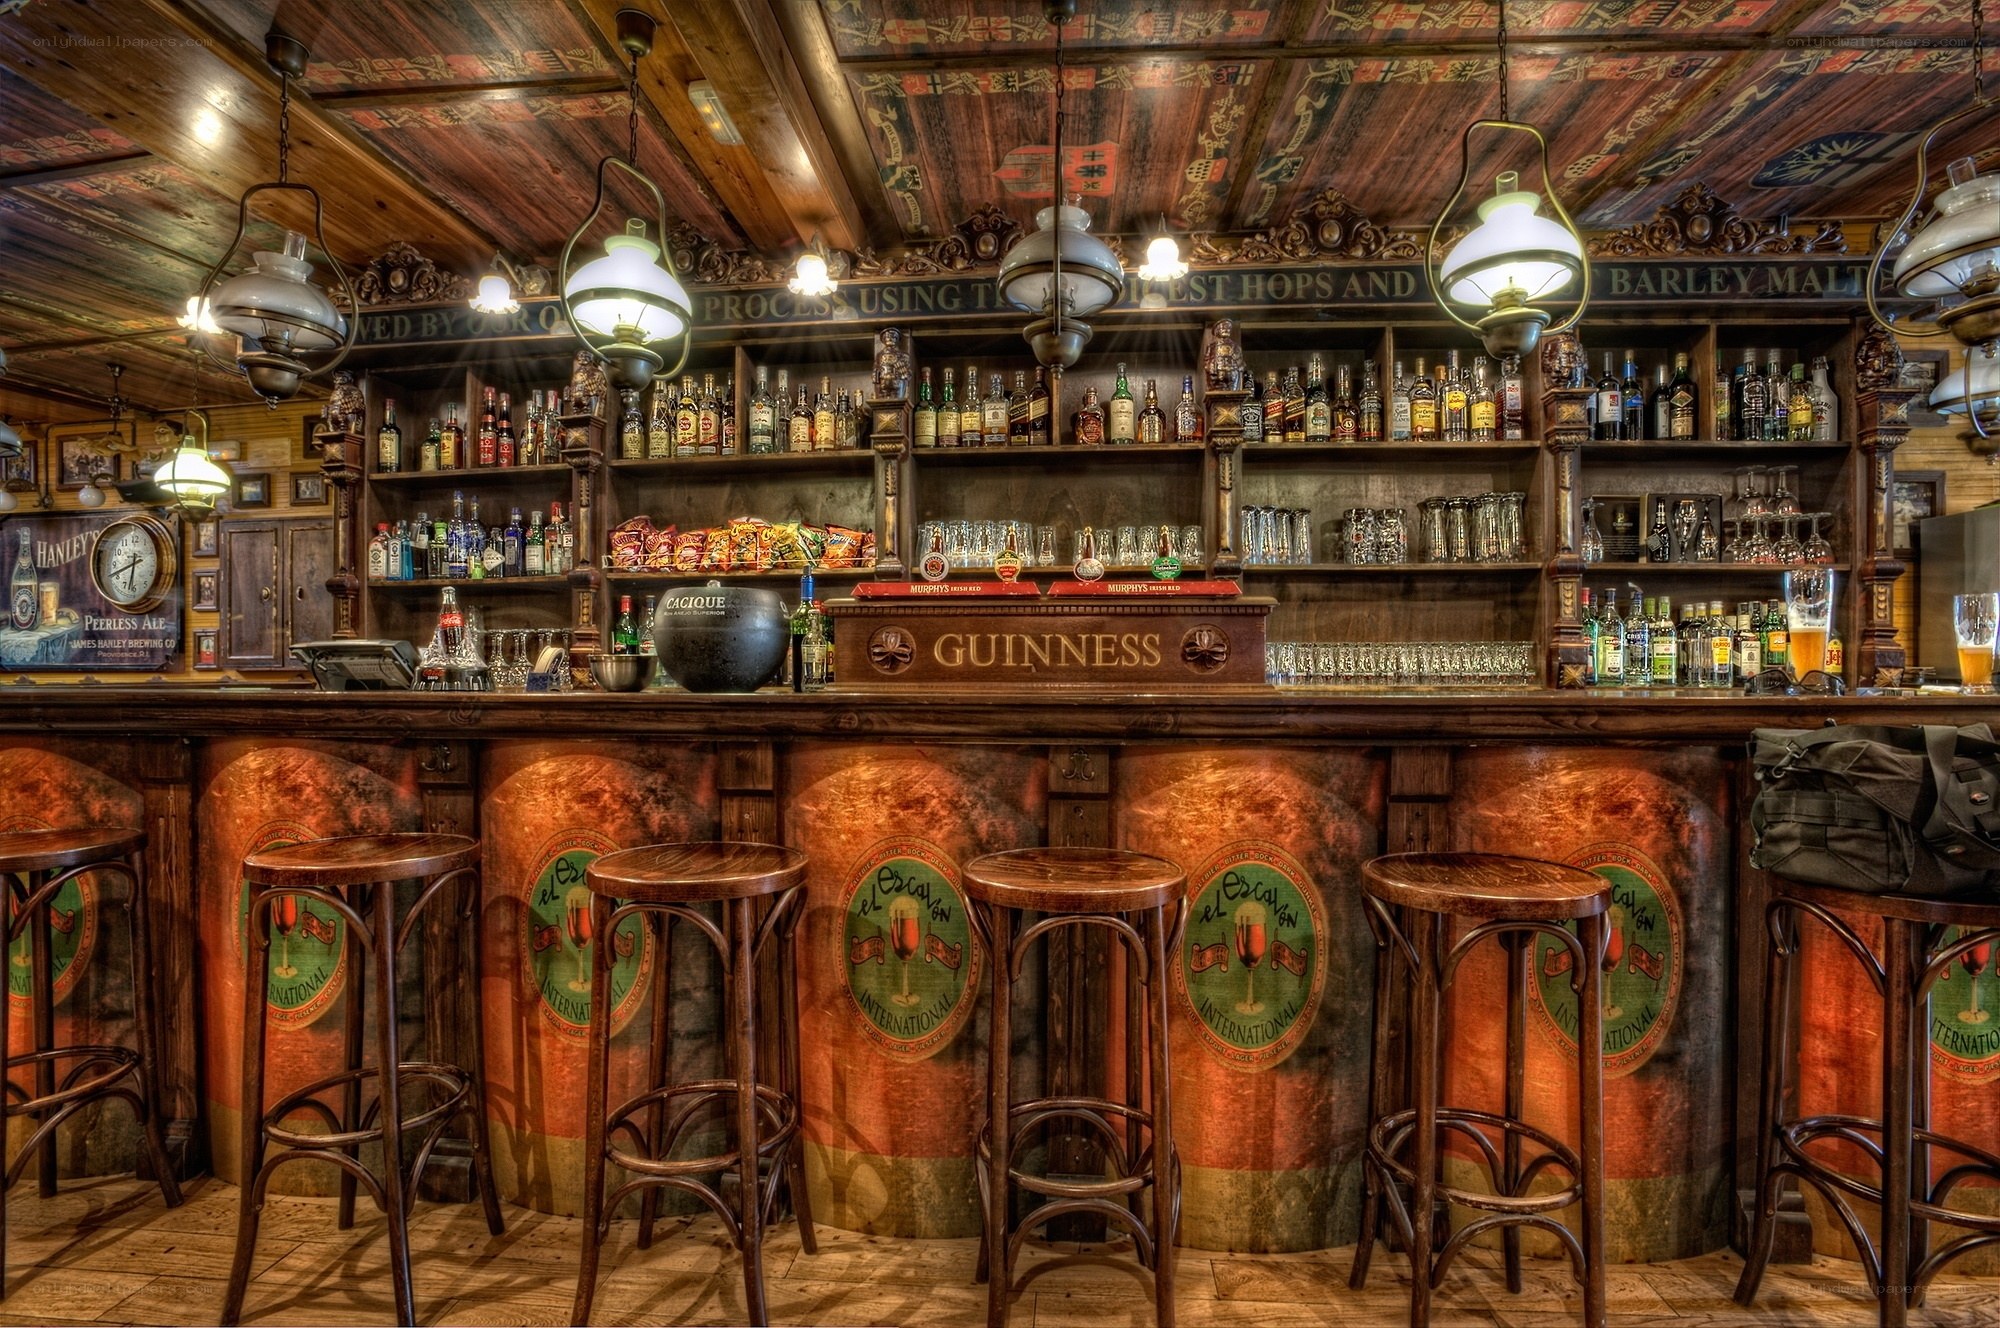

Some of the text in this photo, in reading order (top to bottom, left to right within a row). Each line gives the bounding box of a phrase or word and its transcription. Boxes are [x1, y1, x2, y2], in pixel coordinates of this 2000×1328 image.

[1240, 271, 1337, 303] HOPS
[1342, 269, 1417, 300] AND
[1609, 266, 1758, 296] BARLEY
[1766, 265, 1870, 297] MALT
[703, 287, 850, 321] PROCESS
[860, 283, 966, 314] USING
[420, 312, 459, 338] BY
[466, 309, 531, 335] OUR
[910, 584, 950, 593] MURPHY'S
[1107, 583, 1148, 593] MURPHY'S
[666, 596, 726, 610] CACIQUE
[84, 613, 166, 631] PEERLESS ALE
[71, 639, 97, 649] JAMES
[98, 639, 126, 649] HANLEY
[128, 639, 163, 649] BREWING
[933, 632, 1162, 668] GUINNESS
[1254, 851, 1275, 863] BOCK
[1611, 853, 1632, 865] BOCK
[269, 966, 328, 1006] RNATIONAL
[860, 989, 955, 1036] INTERNATIONAL
[1200, 997, 1299, 1045] INTERNATIONAL
